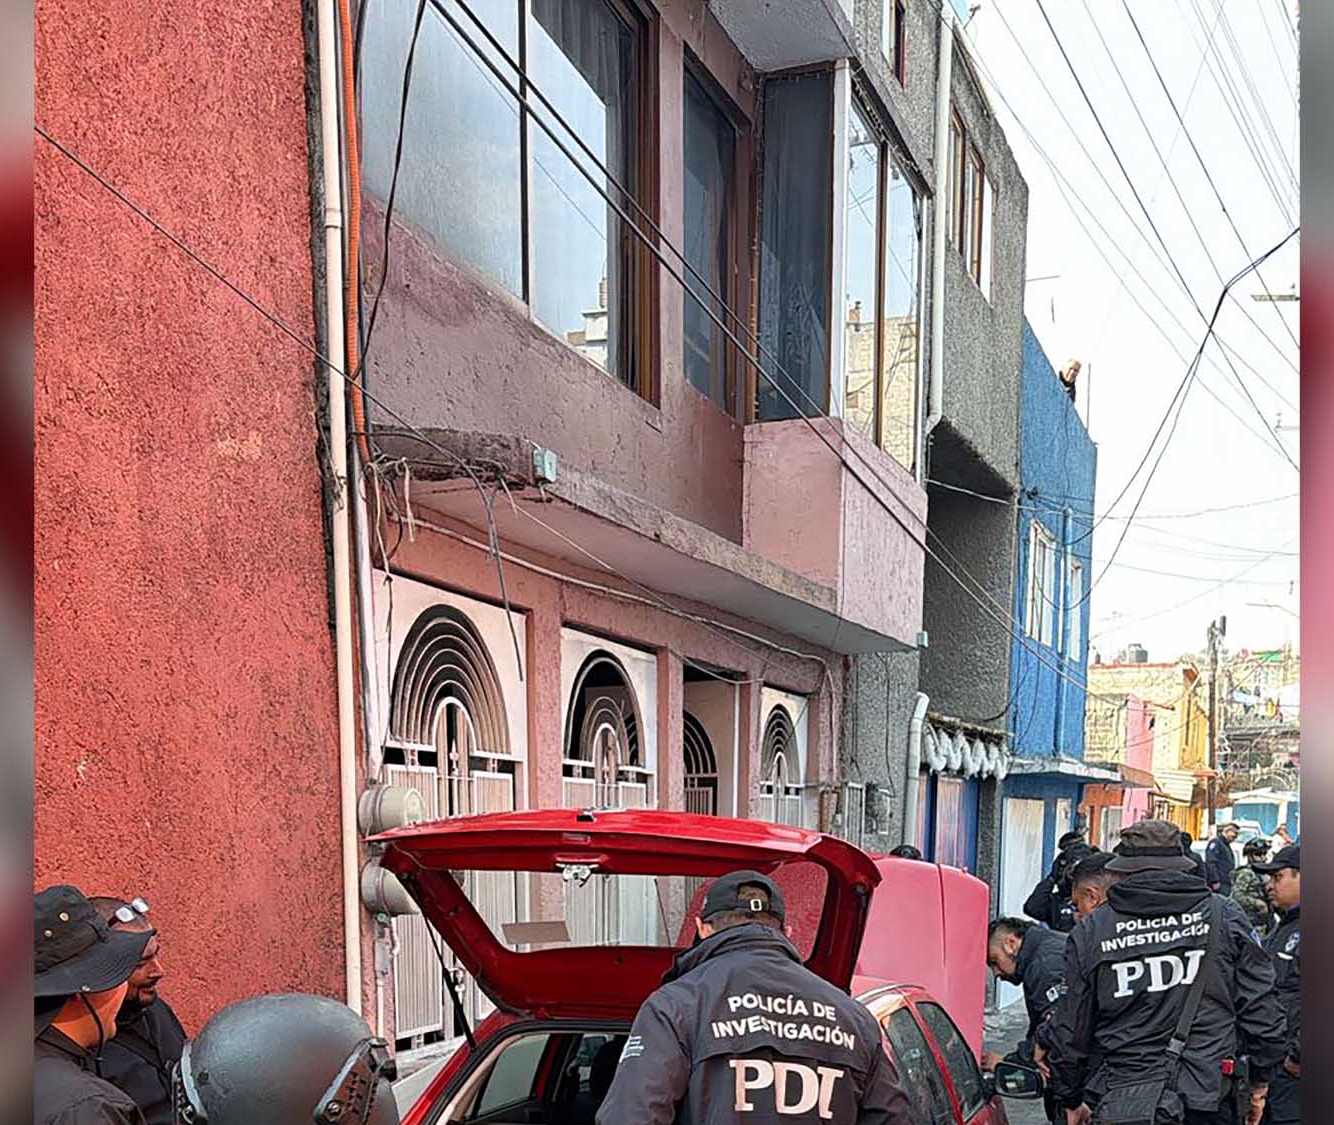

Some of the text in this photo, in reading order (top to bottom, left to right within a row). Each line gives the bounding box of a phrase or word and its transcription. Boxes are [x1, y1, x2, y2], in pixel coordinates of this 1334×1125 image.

[1111, 949, 1206, 998] PDI
[727, 993, 837, 1022] POLICÍA DE
[711, 1015, 856, 1050] INVESTIGACIÓN
[729, 1059, 845, 1120] PDI
